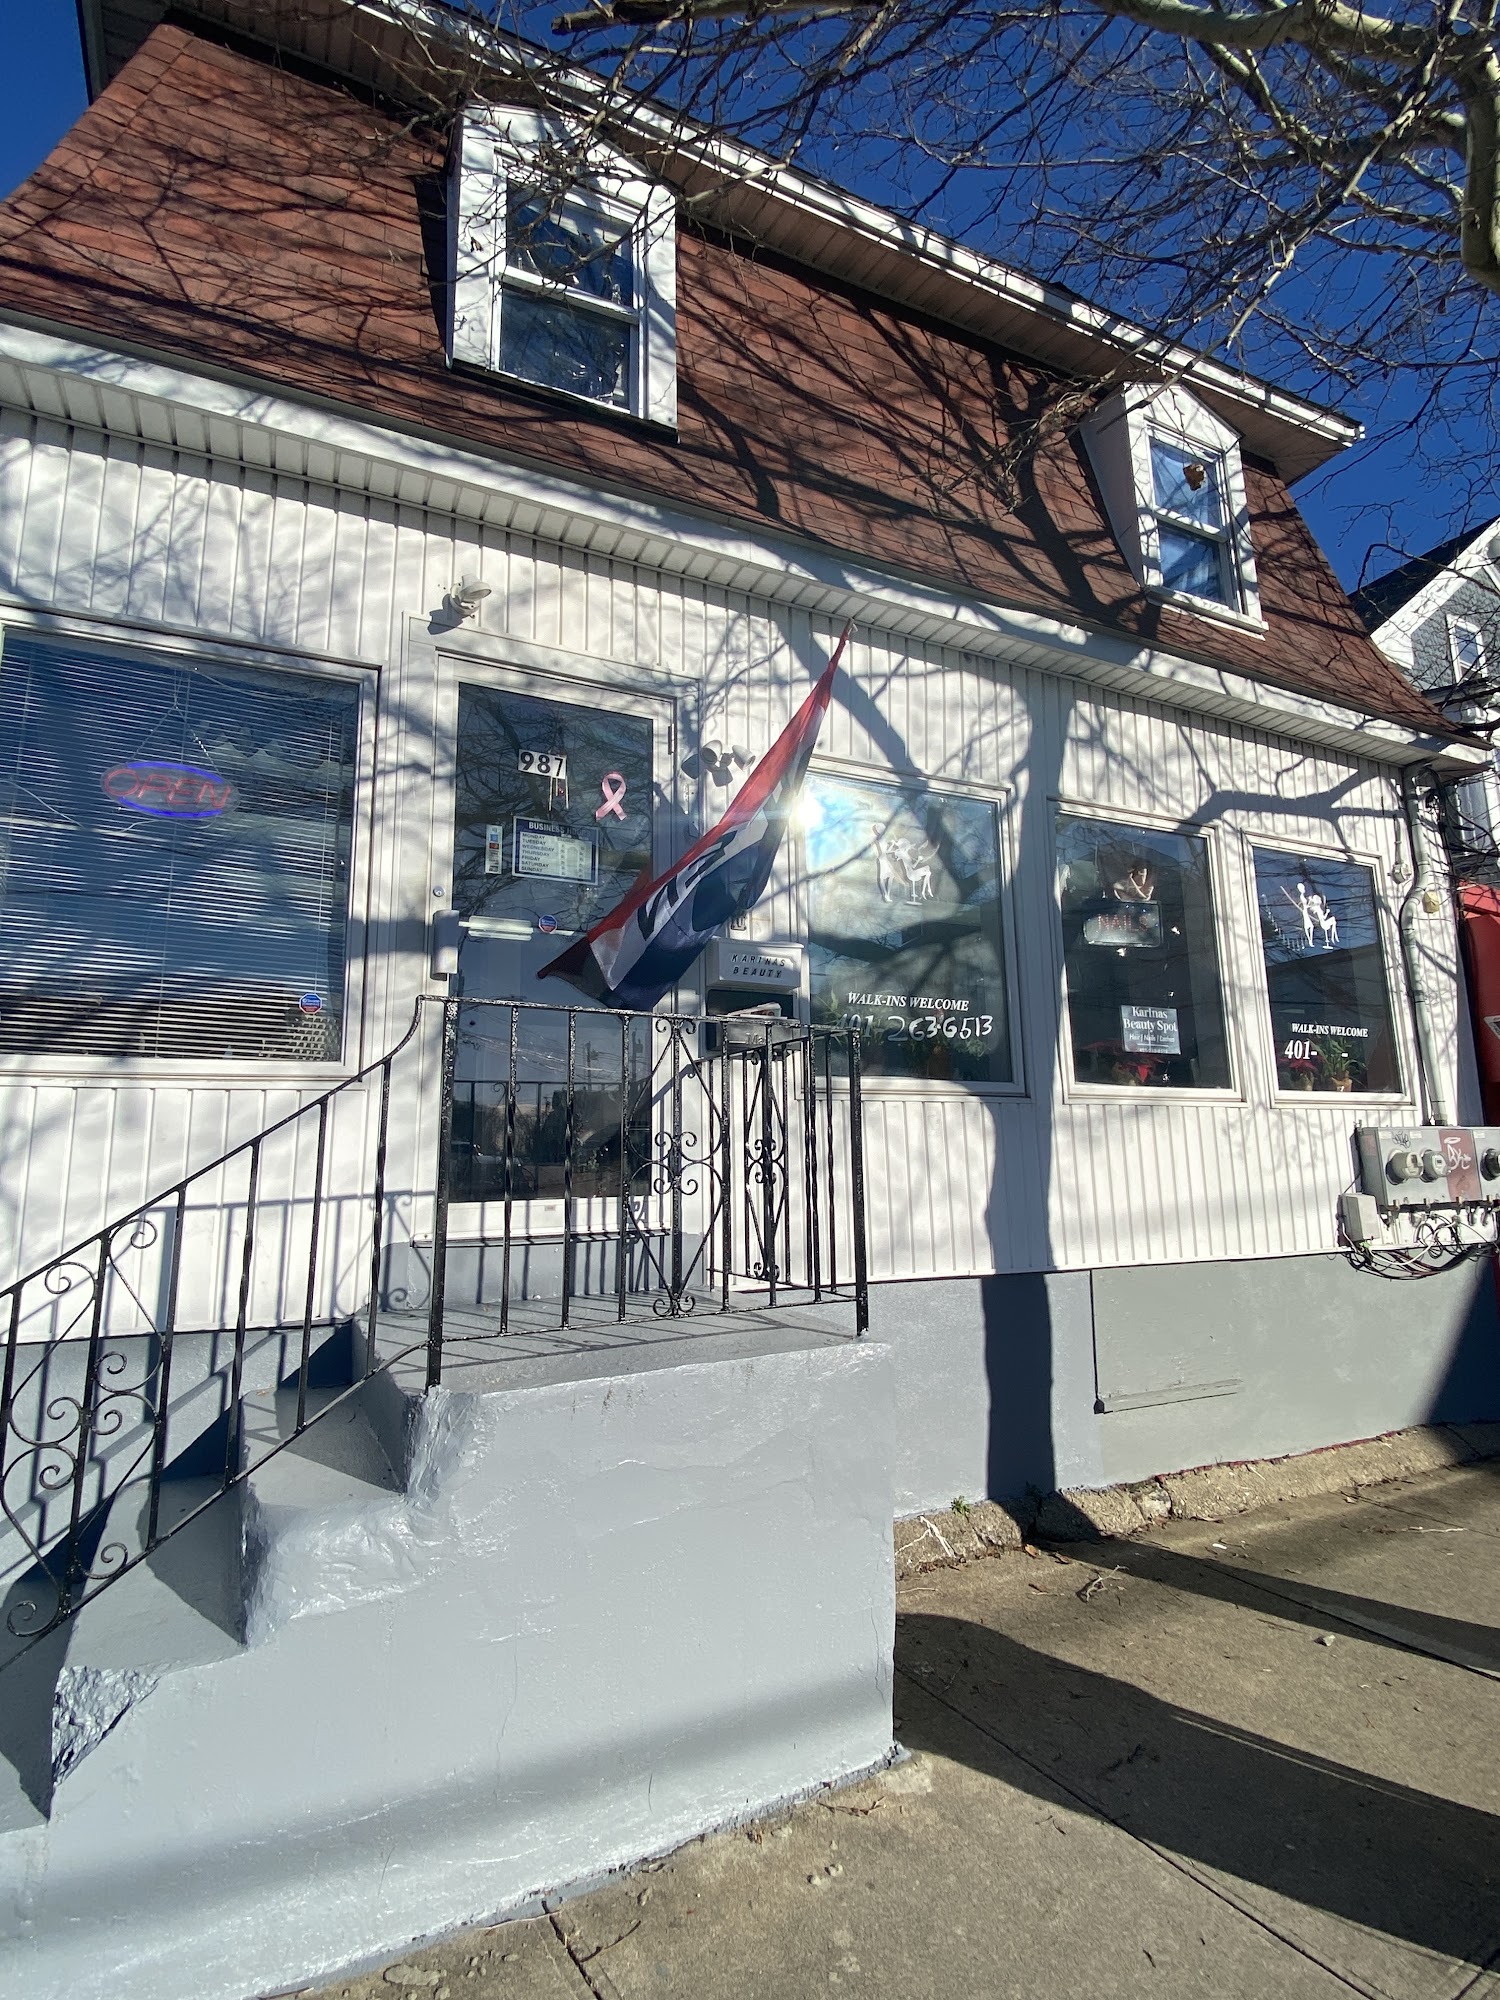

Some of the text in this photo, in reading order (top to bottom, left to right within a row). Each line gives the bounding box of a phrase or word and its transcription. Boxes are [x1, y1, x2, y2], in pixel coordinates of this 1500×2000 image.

[520, 751, 563, 776] 987
[104, 768, 231, 809] OPEN
[528, 821, 565, 834] BUSINESS
[522, 844, 554, 852] WEDNESDAY
[1098, 914, 1148, 932] NAILS
[731, 954, 786, 967] KARINAS
[733, 966, 782, 978] BEAUTY
[848, 991, 969, 1011] WALK-INS WELCOME
[1132, 1006, 1168, 1019] Karinas
[1123, 1018, 1178, 1033] Beauty Spot
[1291, 1023, 1368, 1037] WALK-INS WELCOME
